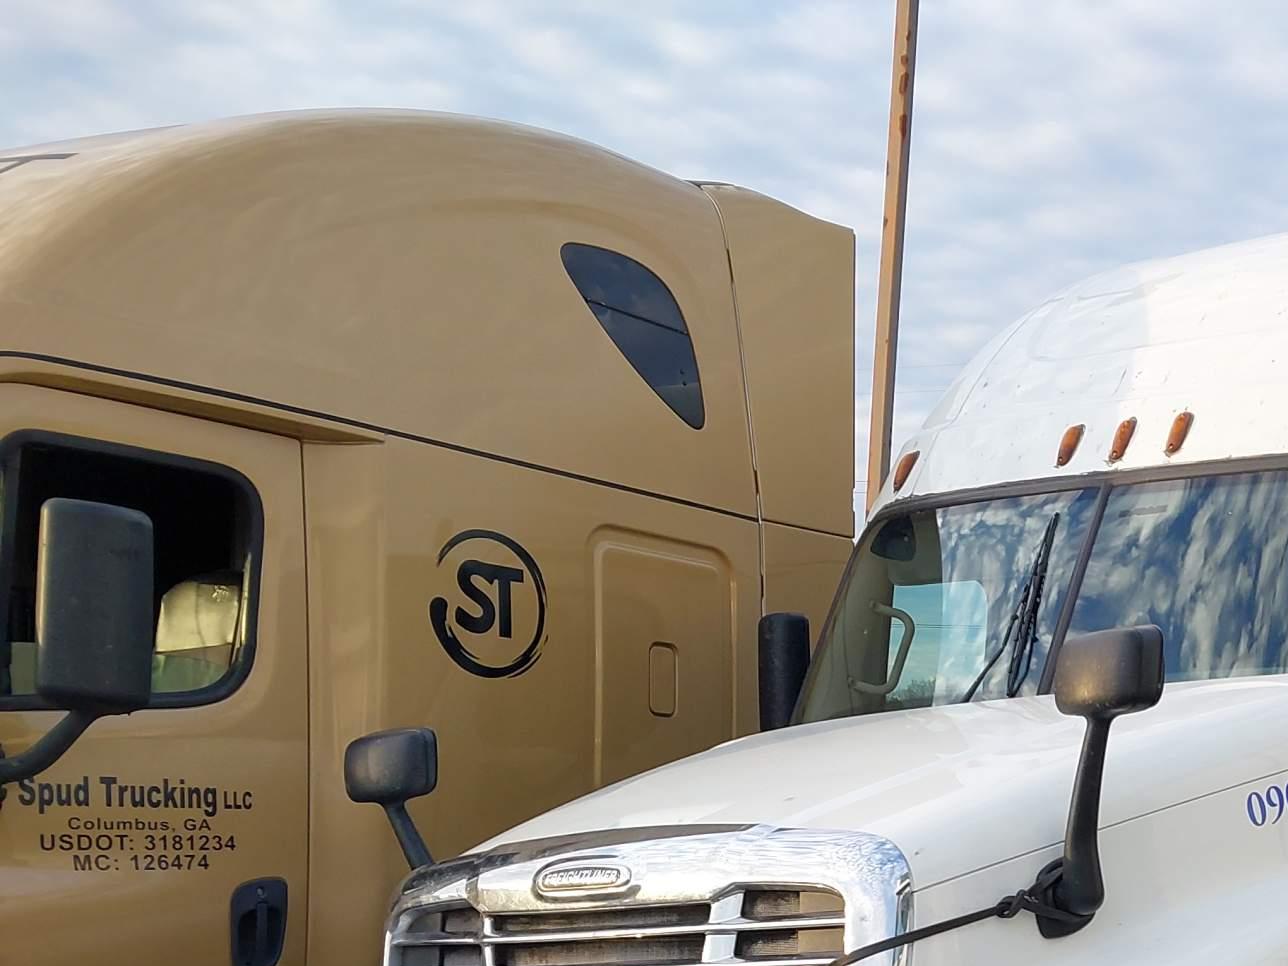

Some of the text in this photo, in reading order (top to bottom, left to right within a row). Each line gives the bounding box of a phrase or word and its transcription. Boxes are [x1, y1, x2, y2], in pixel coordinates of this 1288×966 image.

[455, 559, 524, 638] ST
[18, 776, 89, 815] Spud
[100, 777, 217, 817] Trucking
[223, 790, 253, 810] LLC
[68, 817, 212, 833] Columbus, GA
[39, 834, 237, 851] USDOT: 3181234
[73, 854, 210, 871] MC: 126474
